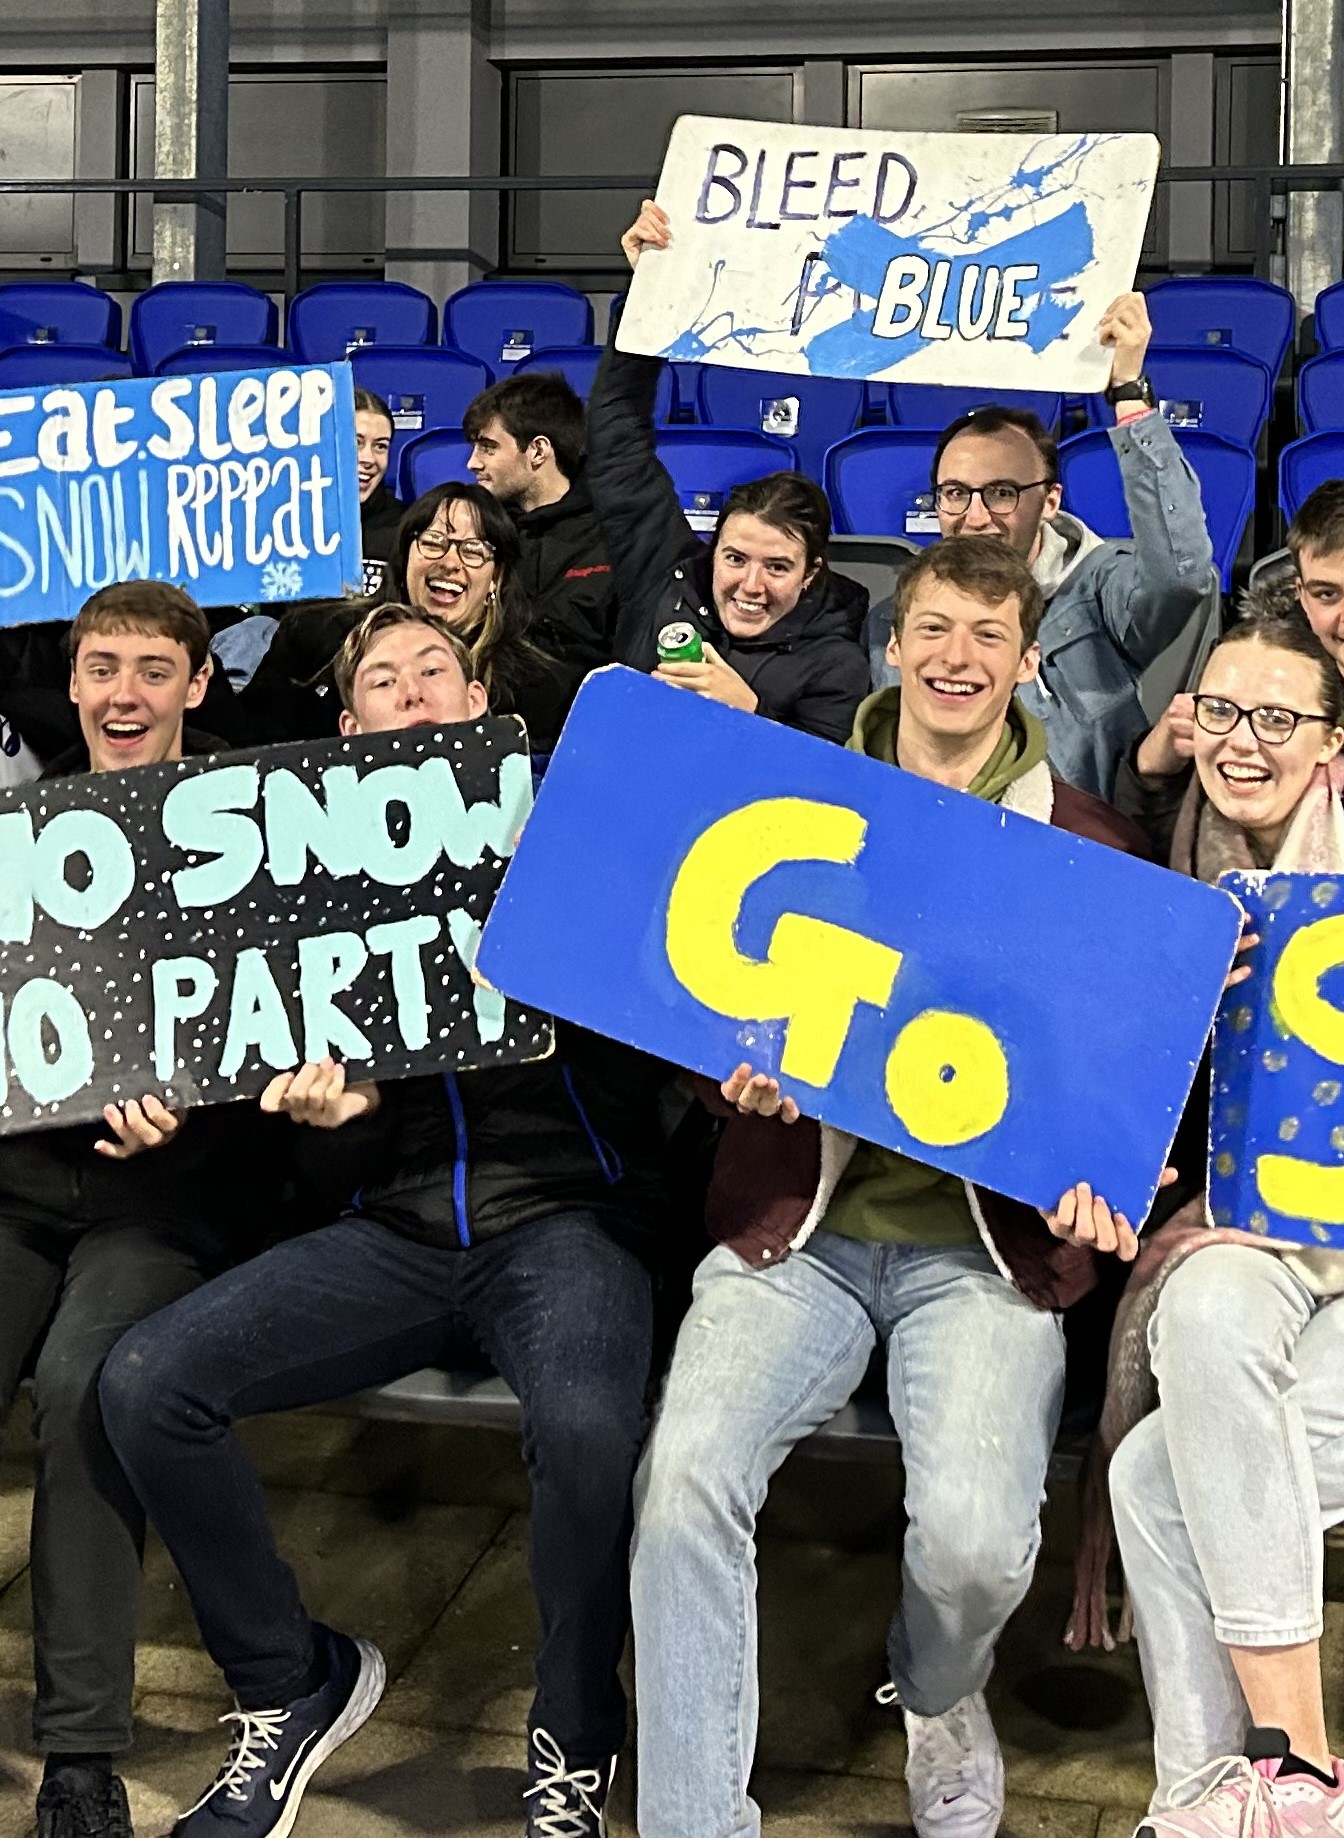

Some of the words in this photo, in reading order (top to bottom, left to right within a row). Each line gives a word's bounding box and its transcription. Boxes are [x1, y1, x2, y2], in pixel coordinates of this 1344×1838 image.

[695, 143, 918, 230] BLEED
[871, 254, 1040, 341] BLUE
[161, 752, 532, 908] SNOW
